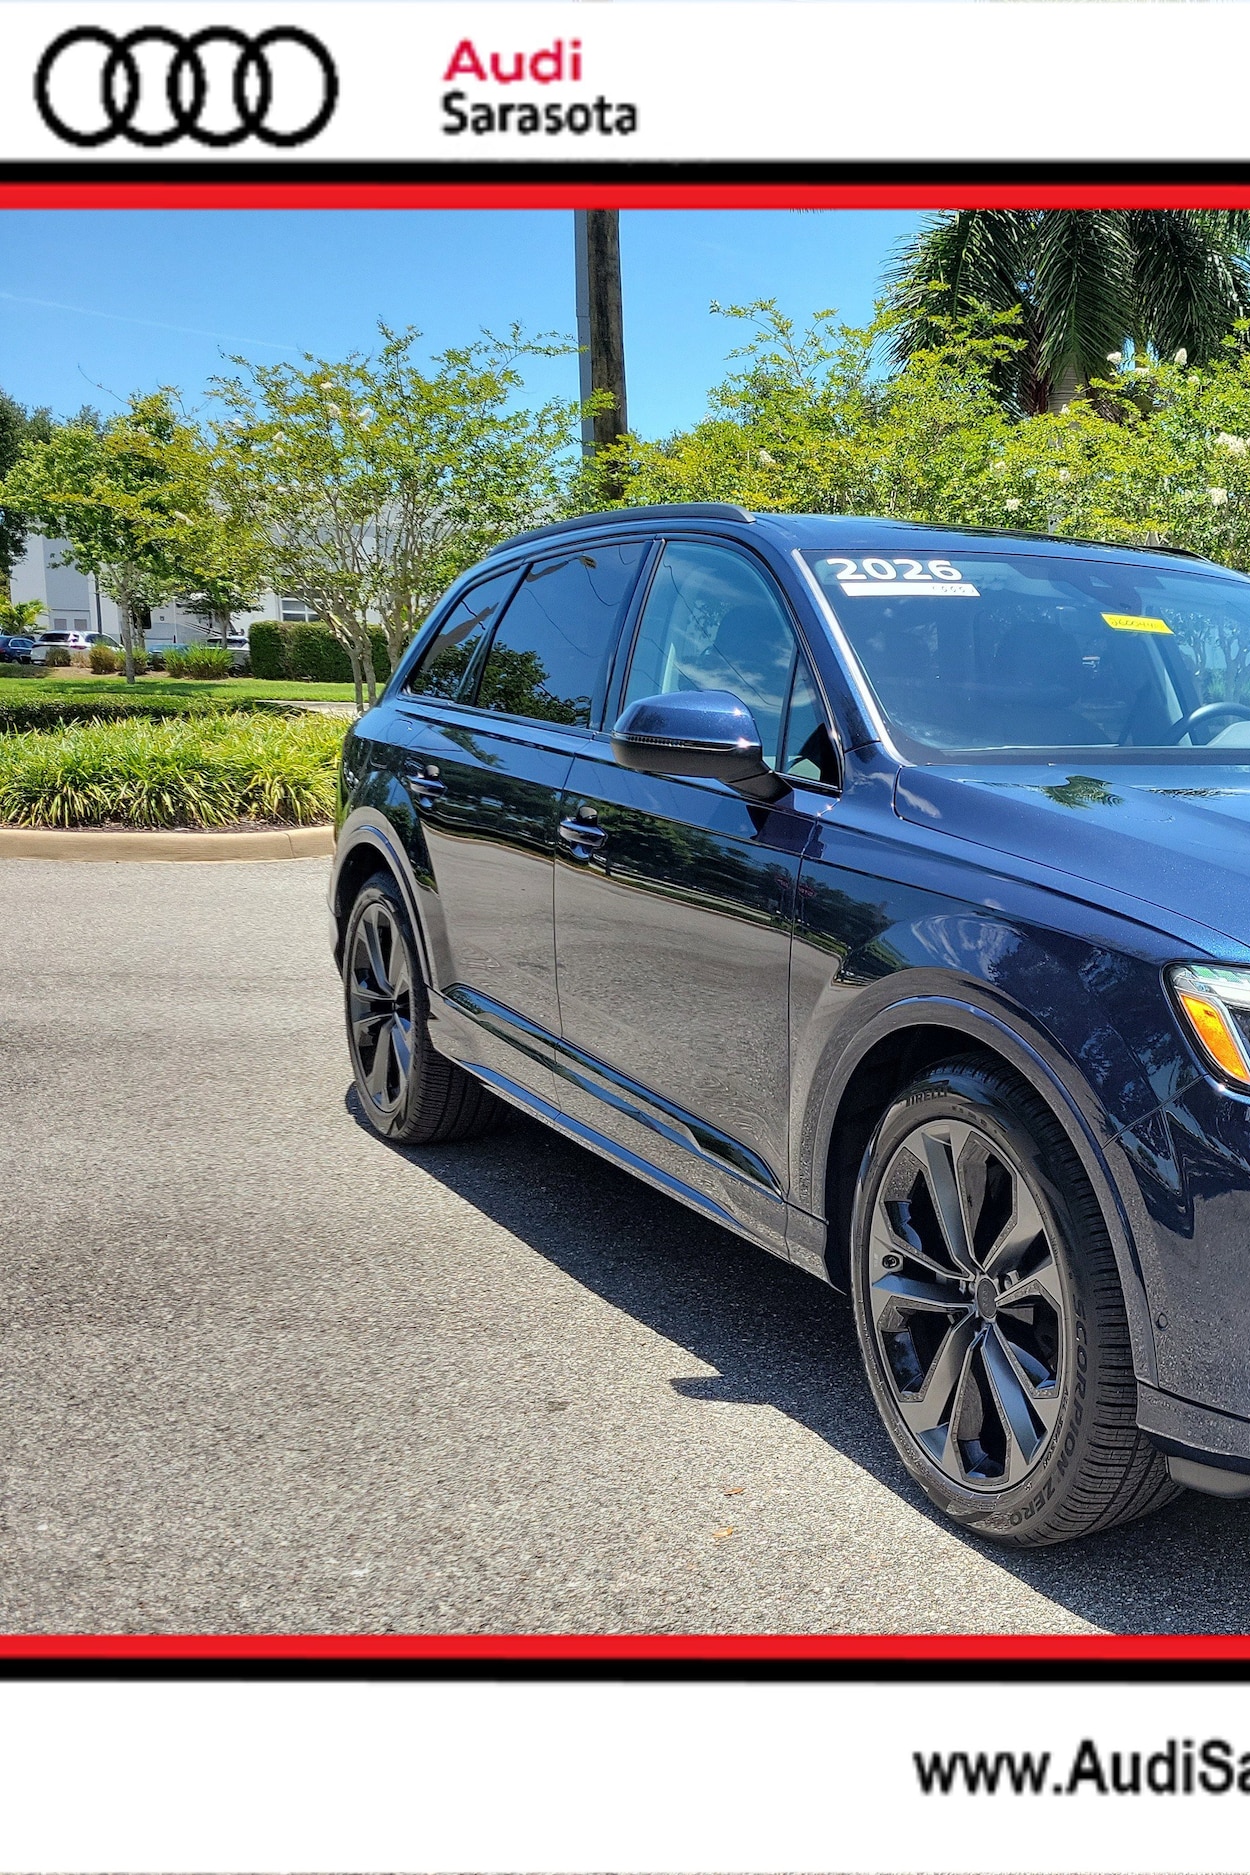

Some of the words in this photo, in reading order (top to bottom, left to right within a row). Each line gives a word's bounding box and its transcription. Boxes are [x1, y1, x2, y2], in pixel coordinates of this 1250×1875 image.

[826, 558, 963, 581] 2026
[1056, 1294, 1088, 1477] SCORPION
[1009, 1476, 1056, 1527] ZERO
